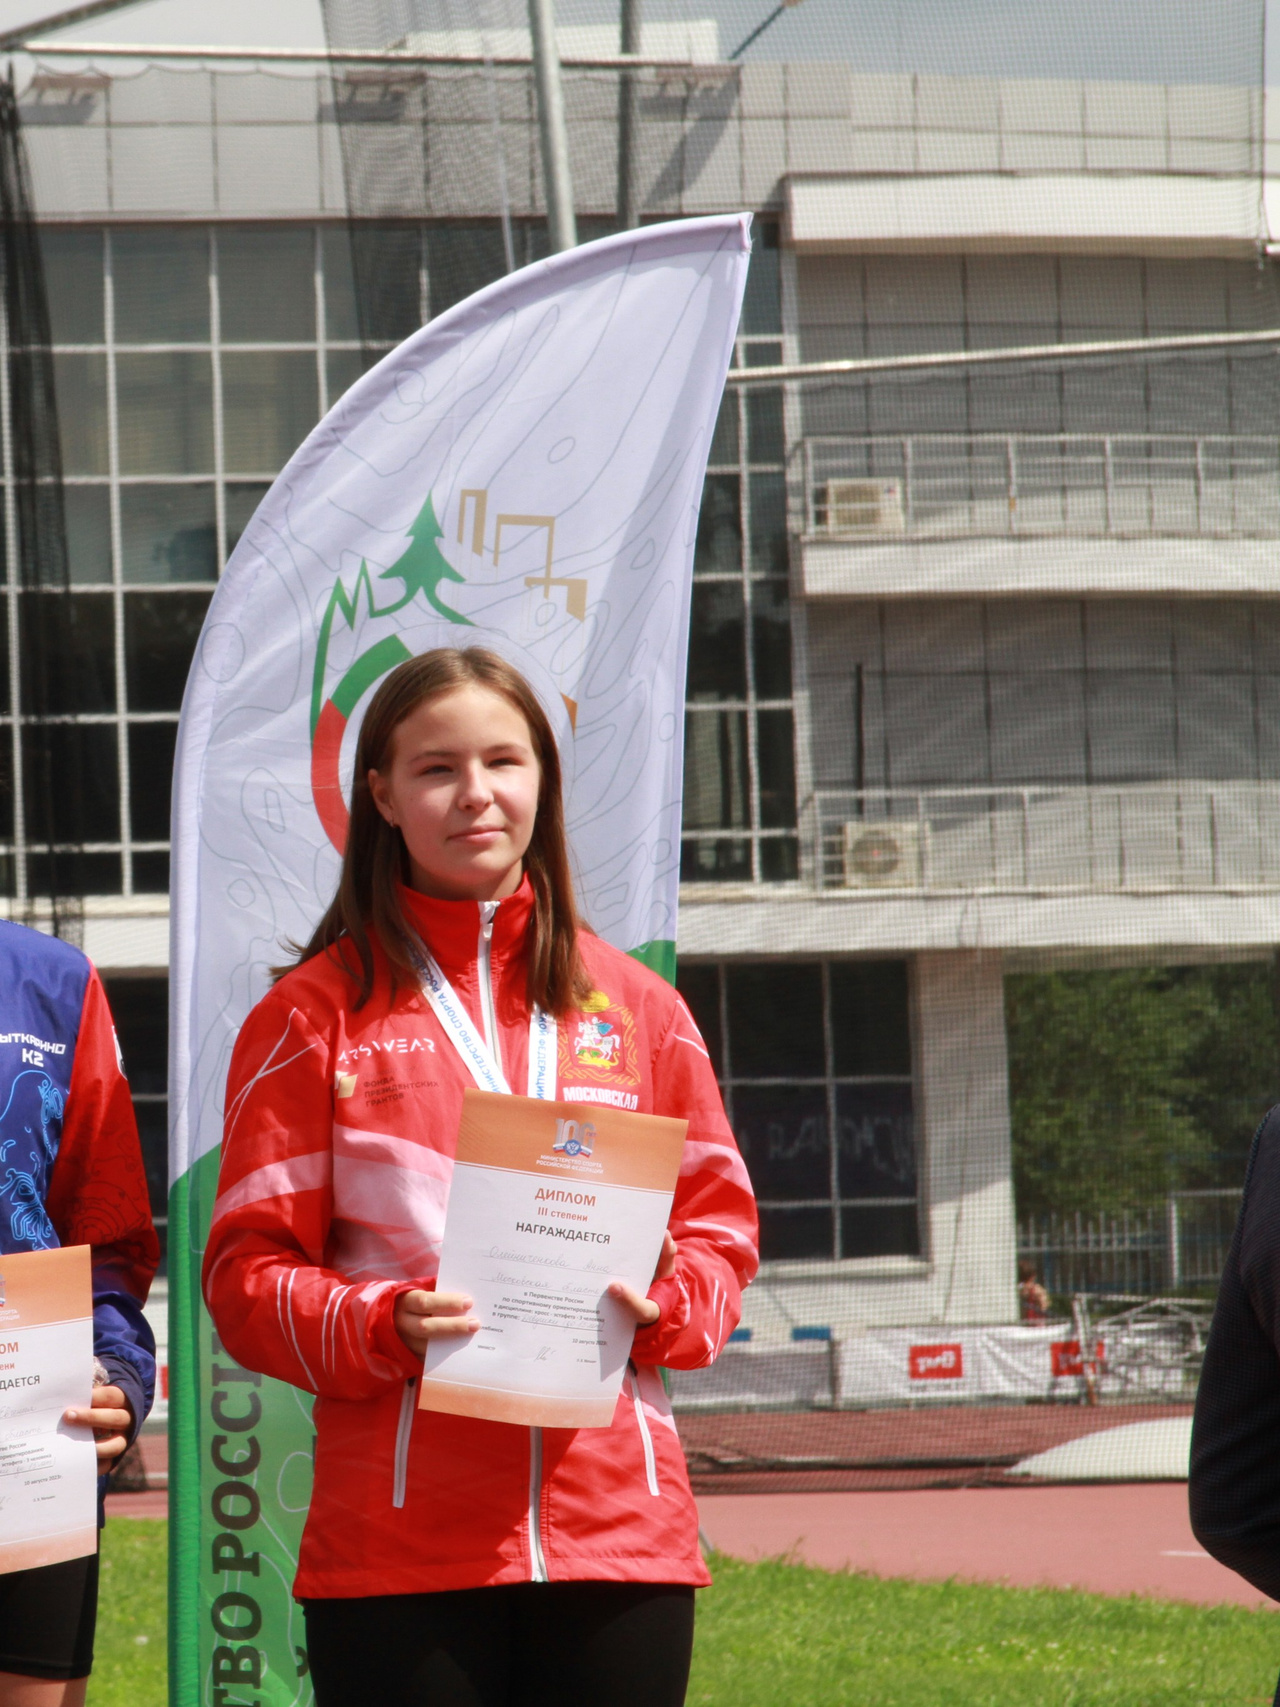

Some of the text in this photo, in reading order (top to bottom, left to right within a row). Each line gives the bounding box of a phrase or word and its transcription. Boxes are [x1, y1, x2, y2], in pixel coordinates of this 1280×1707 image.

[437, 992, 463, 1030] СПОРТА
[363, 1076, 395, 1088] ФОНДА
[364, 1081, 439, 1098] ПРЕЗИДЕНТСКИХ
[366, 1092, 405, 1107] ГРАНТОВ
[562, 1086, 639, 1111] МОСКОВСКАЯ
[534, 1187, 596, 1208] ДИПЛОМ
[537, 1206, 588, 1222] III степени
[515, 1221, 611, 1246] НАГРАЖДАЕТСЯ
[511, 1297, 551, 1309] спортивному
[528, 1291, 563, 1302] Первенстве
[564, 1297, 584, 1305] России
[496, 1311, 520, 1321] группе:
